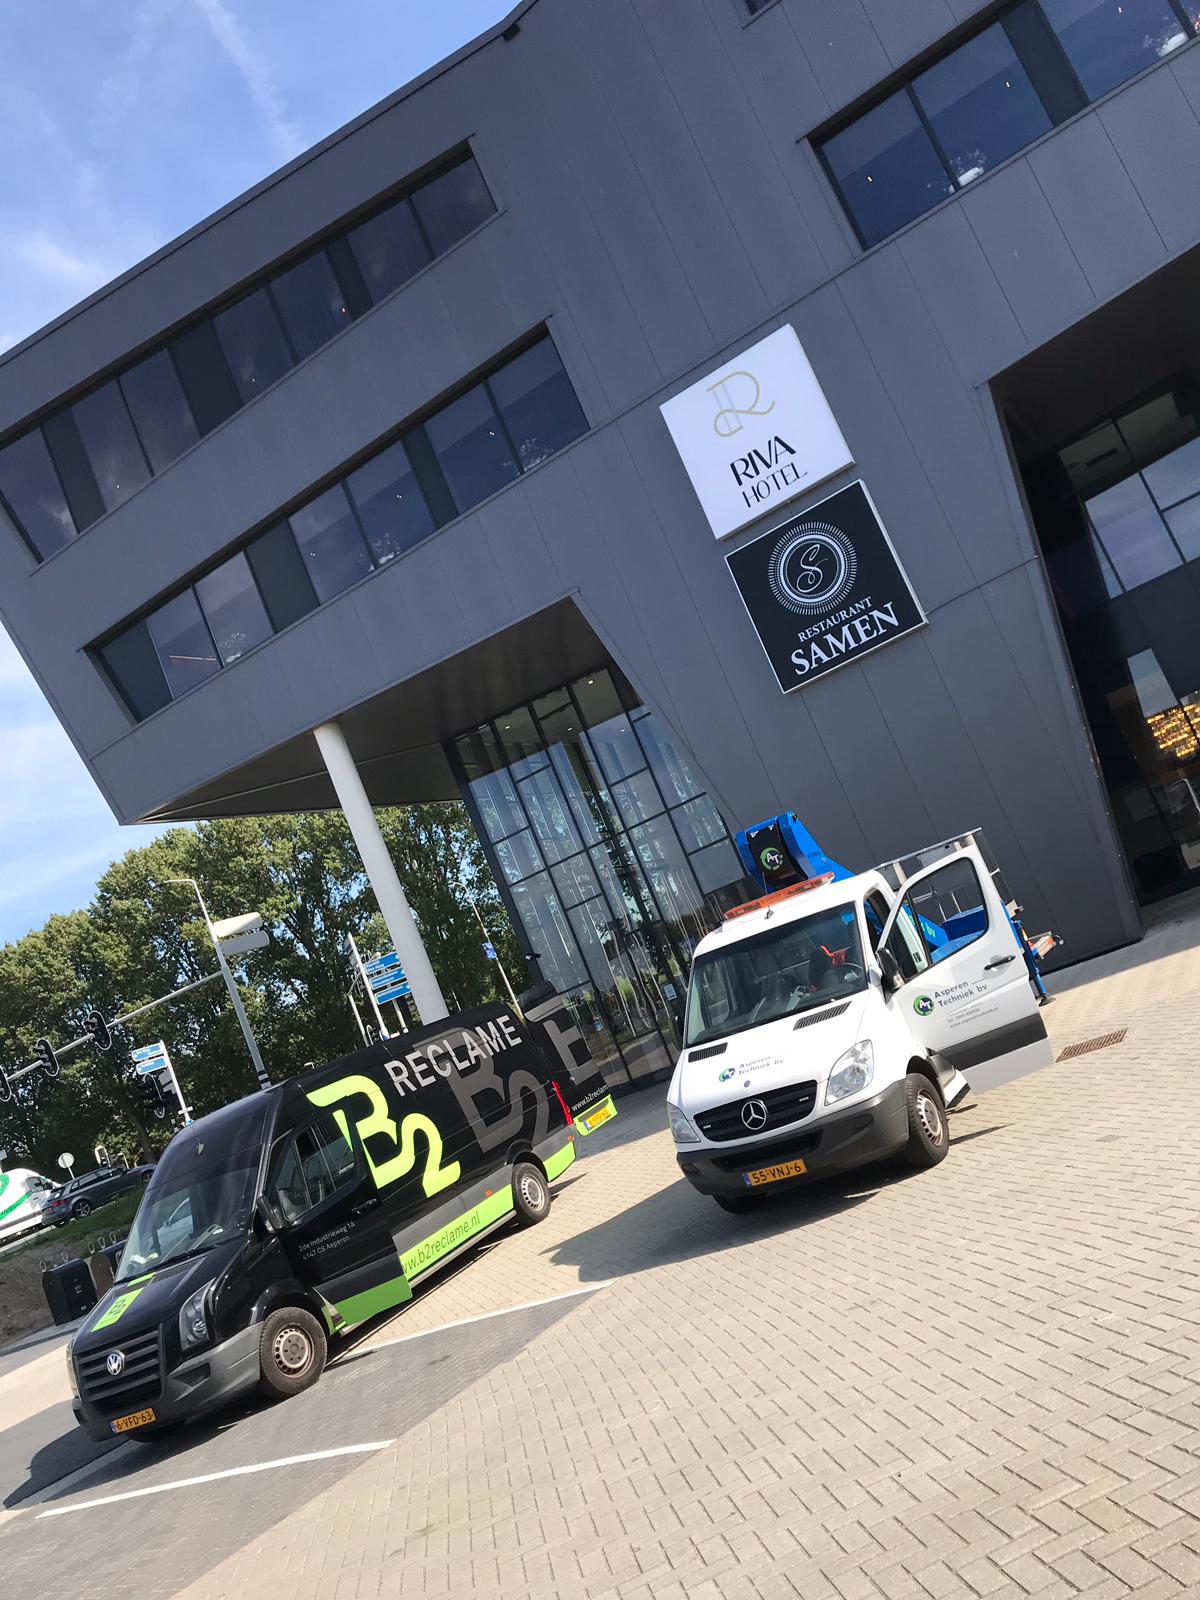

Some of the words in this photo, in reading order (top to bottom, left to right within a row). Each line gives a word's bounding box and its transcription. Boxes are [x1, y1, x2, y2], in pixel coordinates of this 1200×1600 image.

[730, 435, 797, 487] RIVA
[742, 462, 808, 508] HOTEL
[790, 602, 900, 675] SAMEN
[798, 596, 873, 643] RESTAURANT
[934, 981, 969, 999] Asperen
[938, 989, 974, 1008] Techniek
[976, 984, 988, 992] bv
[384, 1014, 523, 1097] RECLAME
[306, 1075, 461, 1198] B2
[752, 1162, 802, 1183] 55-VNJ-6
[310, 1226, 348, 1246] Industrieweg
[316, 1245, 326, 1254] CS
[326, 1235, 351, 1250] Asperen
